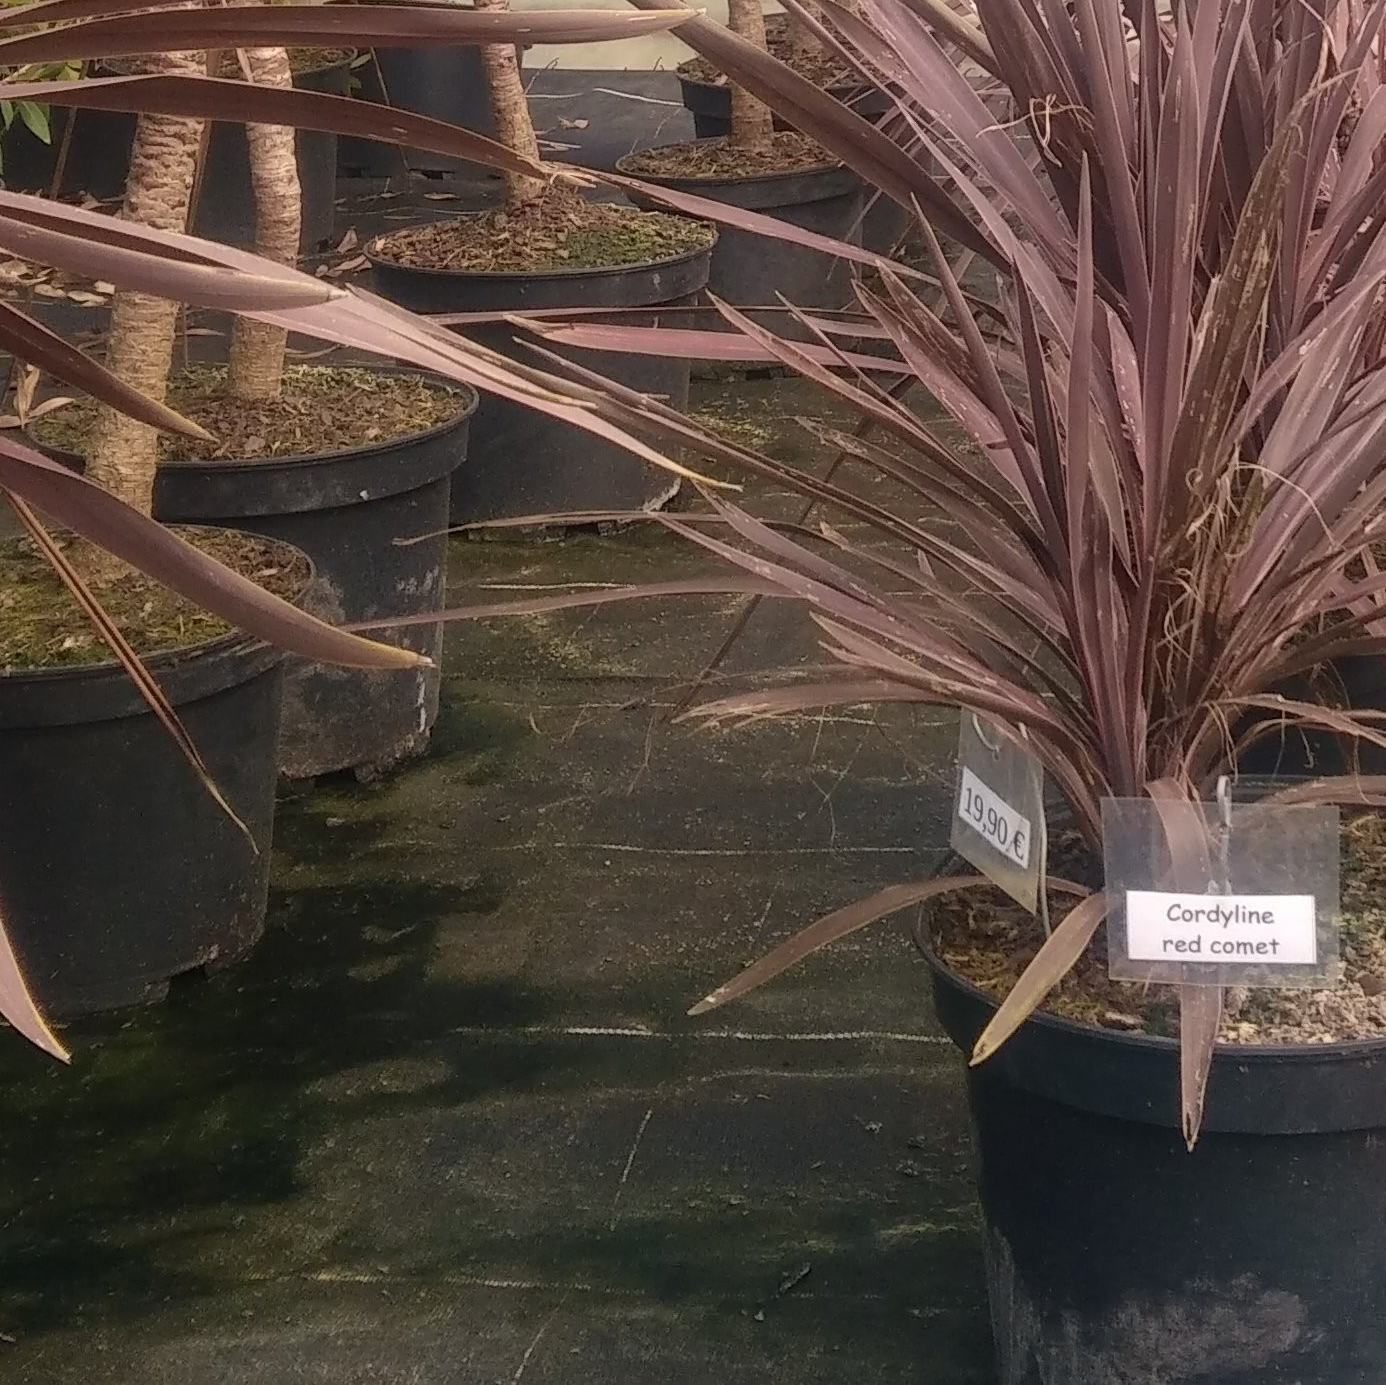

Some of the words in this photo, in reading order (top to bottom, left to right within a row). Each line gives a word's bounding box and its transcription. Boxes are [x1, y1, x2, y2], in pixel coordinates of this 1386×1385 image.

[964, 787, 1008, 845] 19,90
[1013, 830, 1026, 860] €
[1166, 903, 1275, 929] Cordyline
[1162, 934, 1202, 954] red
[1209, 938, 1281, 956] comet
